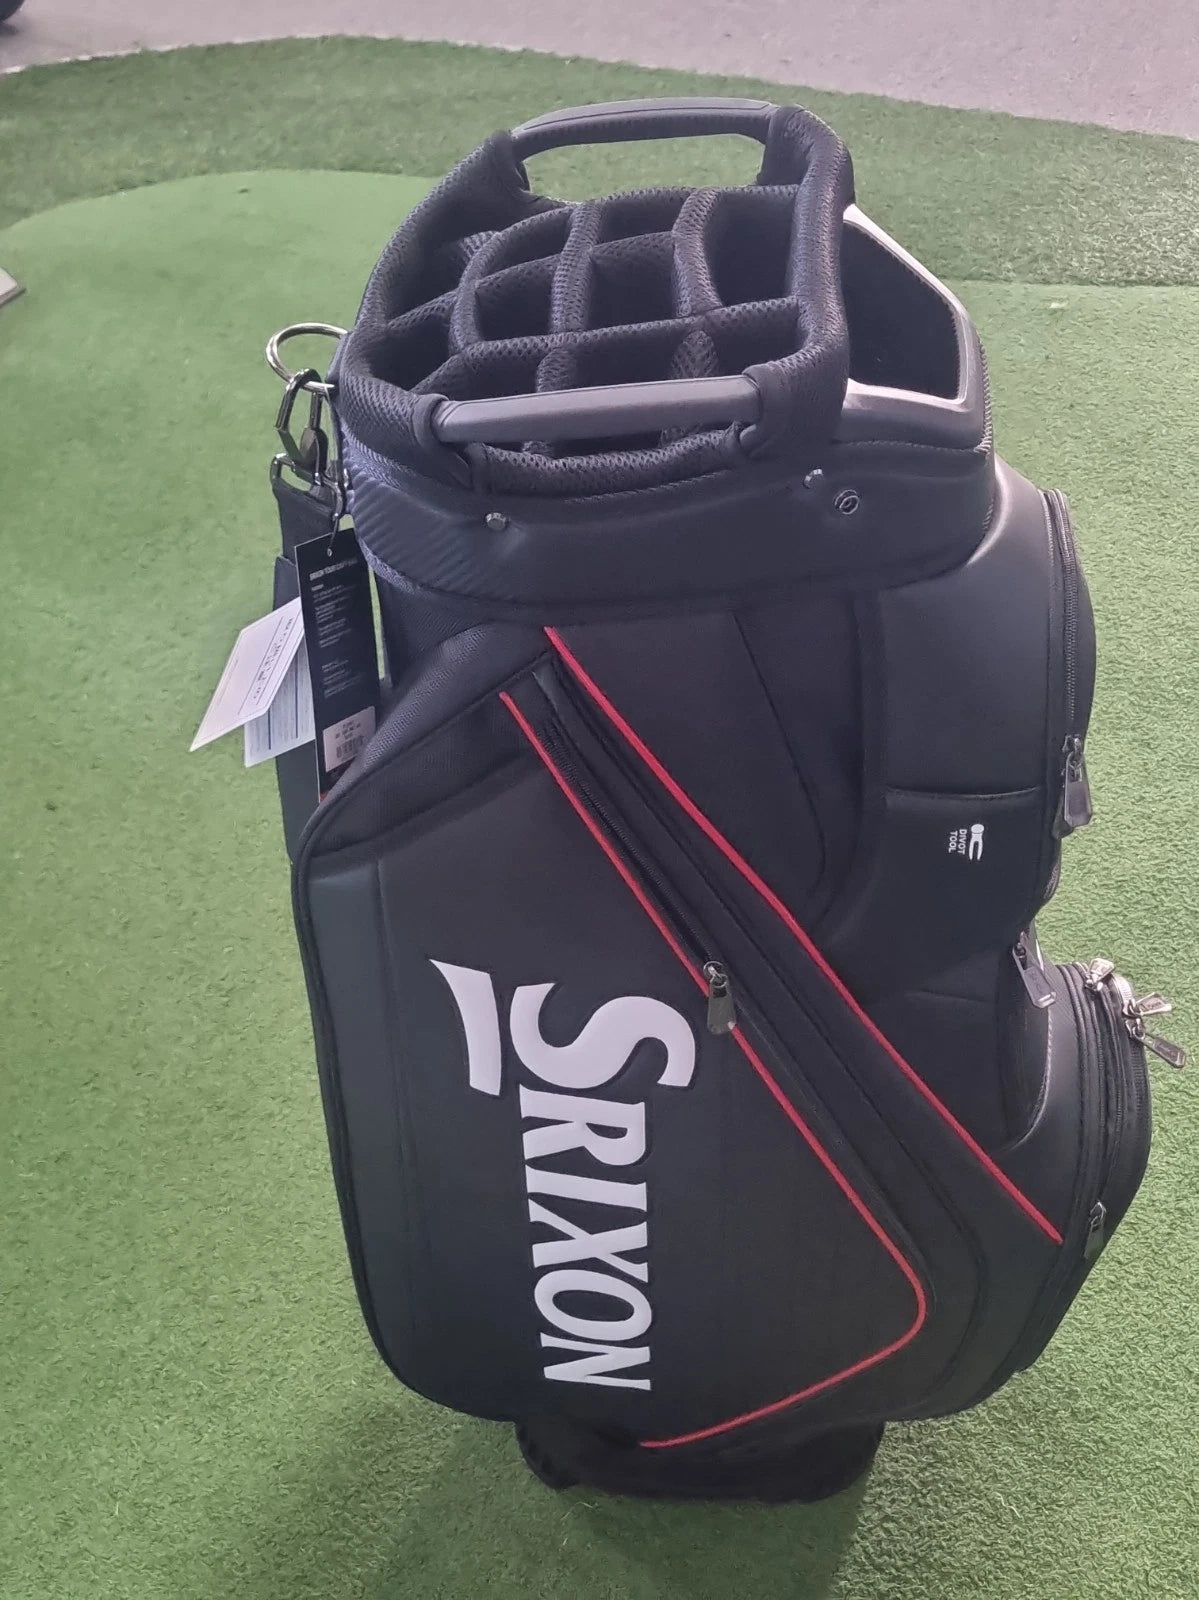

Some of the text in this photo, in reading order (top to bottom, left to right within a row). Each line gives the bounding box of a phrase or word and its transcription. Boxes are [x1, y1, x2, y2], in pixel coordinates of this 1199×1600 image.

[948, 830, 958, 853] TOOL
[957, 829, 967, 855] DIVOT
[509, 982, 696, 1391] SRIXON
